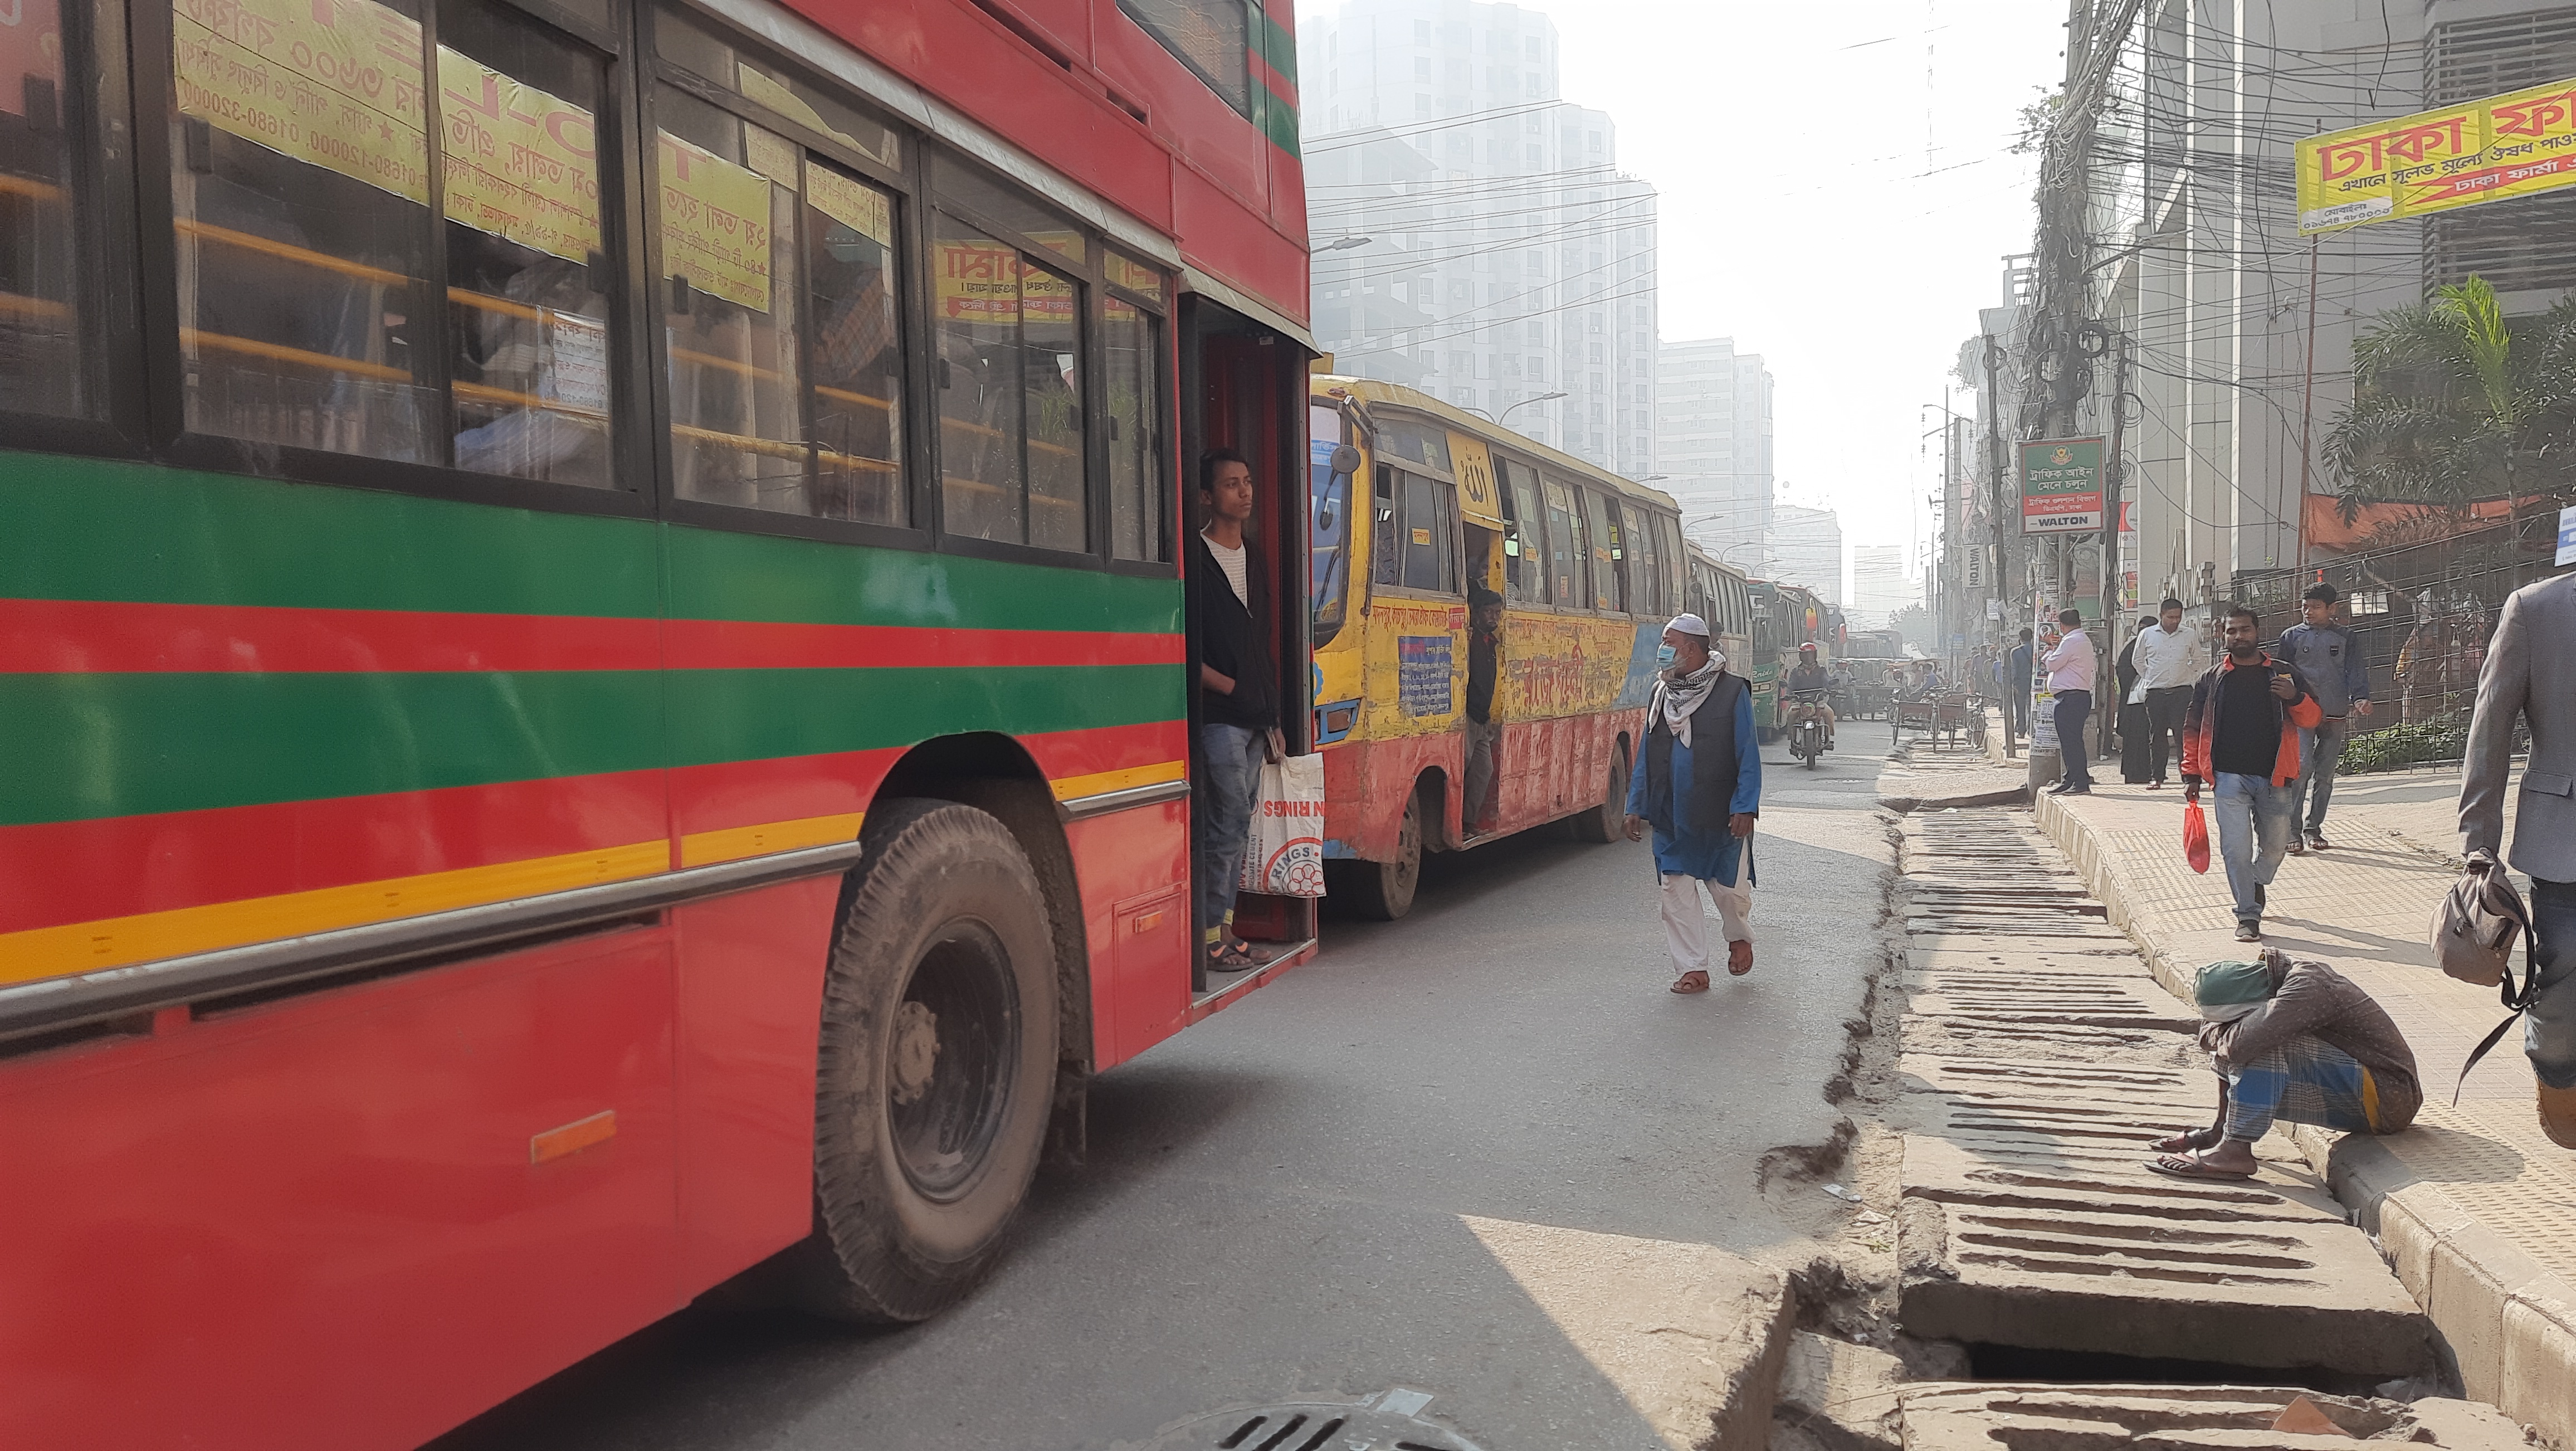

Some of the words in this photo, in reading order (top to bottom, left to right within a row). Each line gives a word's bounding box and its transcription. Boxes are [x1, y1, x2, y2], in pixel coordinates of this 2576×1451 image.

[2316, 116, 2467, 182] ঢাকা
[2338, 173, 2386, 191] এখানে
[2440, 153, 2483, 173] মূল্যে
[2491, 143, 2533, 160] ঔষধ
[2540, 134, 2576, 149] পাও
[2455, 173, 2500, 191] ঢাকা
[2507, 160, 2559, 178] ফার্মা
[2029, 469, 2063, 481] ট্রাফিক
[2064, 466, 2094, 478] আইন
[2038, 481, 2062, 490] মেনে
[2064, 479, 2088, 490] চলুন
[2038, 516, 2088, 527] WALTON
[1969, 548, 1979, 586] WALTON
[1263, 800, 1310, 817] RINGS
[1271, 847, 1310, 879] RINGS
